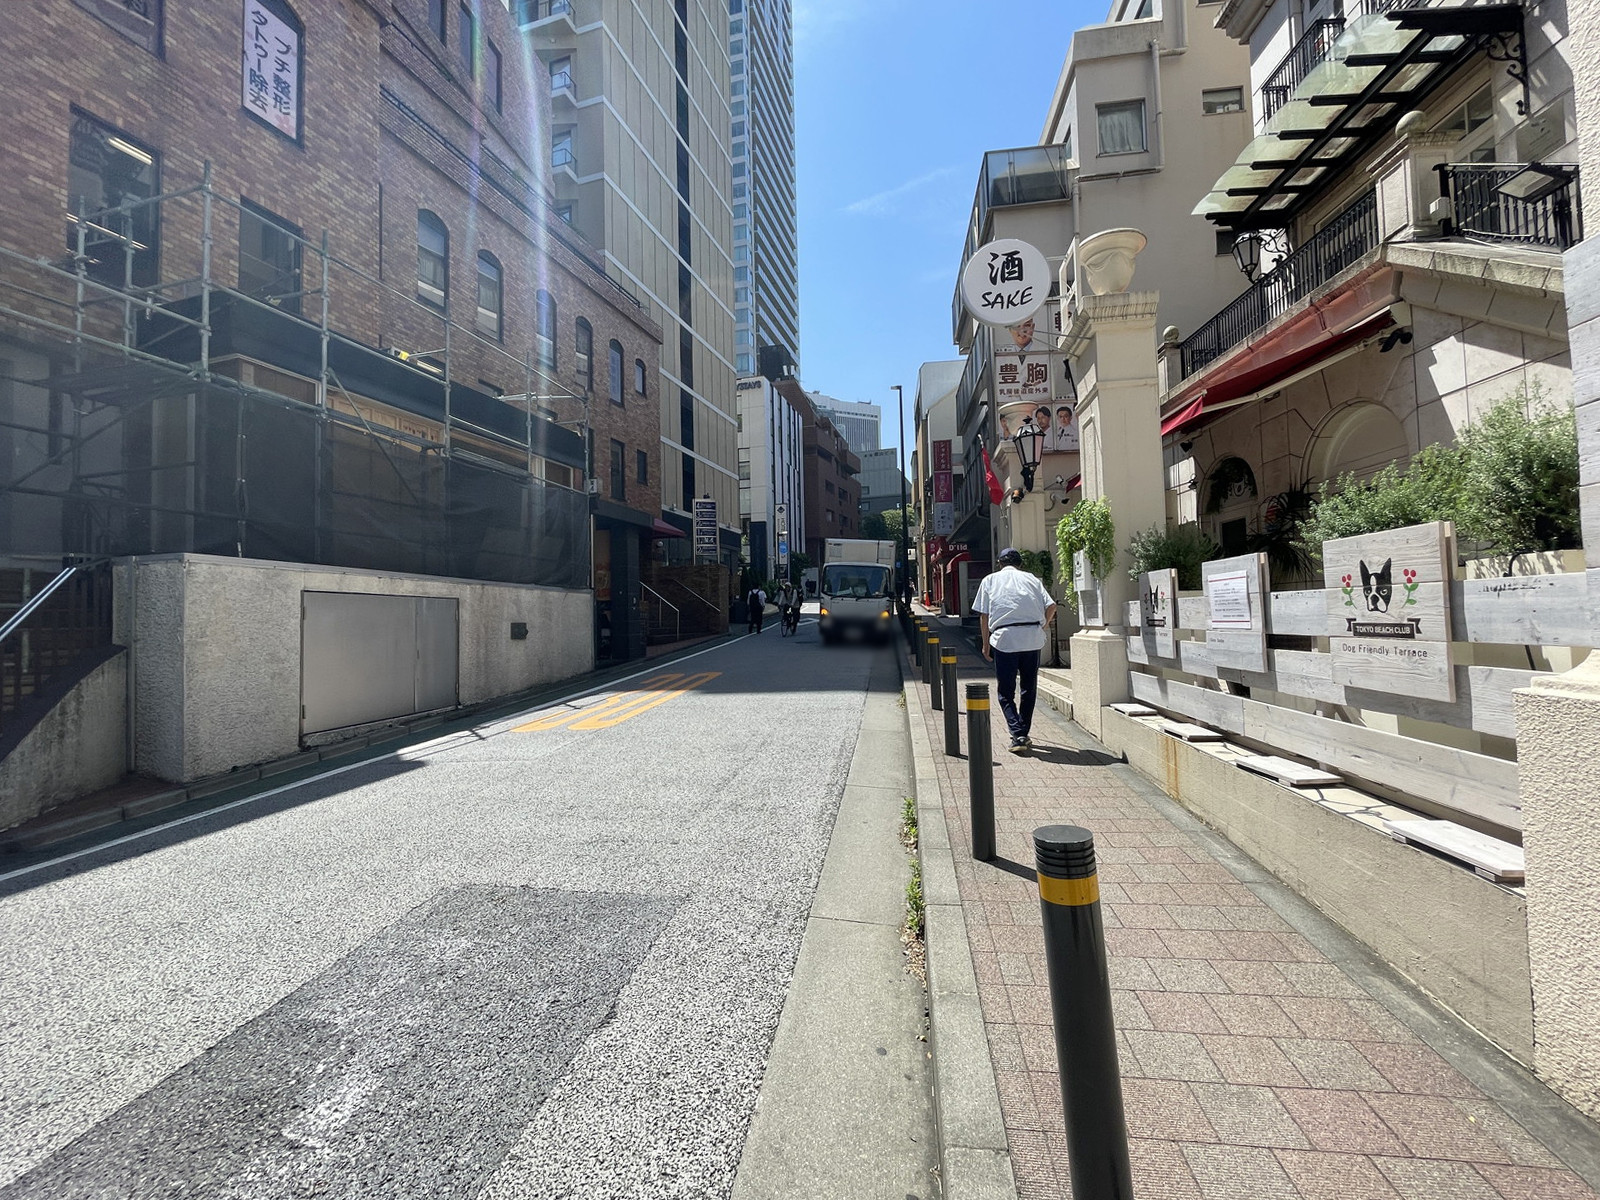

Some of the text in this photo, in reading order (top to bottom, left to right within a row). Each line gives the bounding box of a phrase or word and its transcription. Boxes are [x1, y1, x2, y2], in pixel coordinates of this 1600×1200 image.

[248, 10, 269, 114] タトゥー除去
[272, 35, 293, 116] プチ整形
[987, 250, 1024, 286] 酒
[981, 286, 1034, 310] SAKE
[998, 362, 1048, 385] 豊胸
[1375, 626, 1394, 634] BEACH
[1342, 643, 1428, 657] Dog Friendly Terrace
